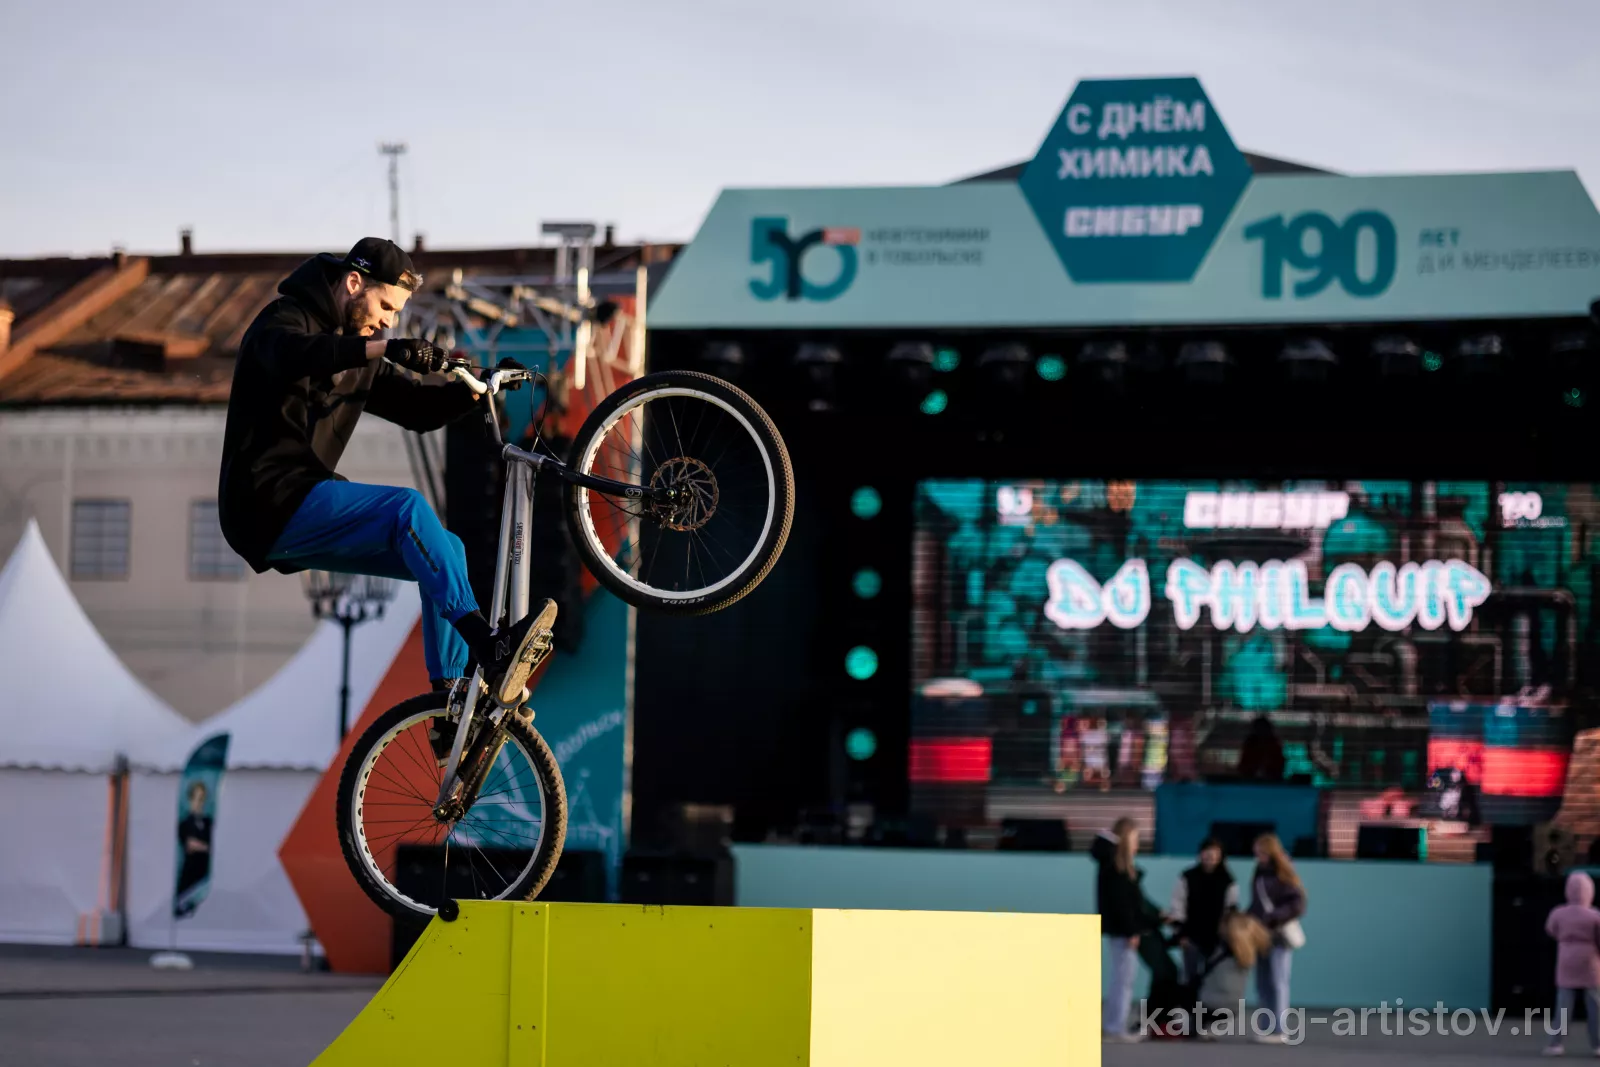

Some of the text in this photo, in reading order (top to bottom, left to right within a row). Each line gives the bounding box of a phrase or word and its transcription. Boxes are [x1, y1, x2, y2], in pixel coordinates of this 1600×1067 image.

[1066, 94, 1206, 140] С ДНЁМ
[1057, 144, 1214, 180] ХИМИКА
[1063, 204, 1204, 238] СИБУР
[1243, 208, 1397, 300] 190
[662, 596, 705, 605] KENDA
[1044, 557, 1151, 630] DJ
